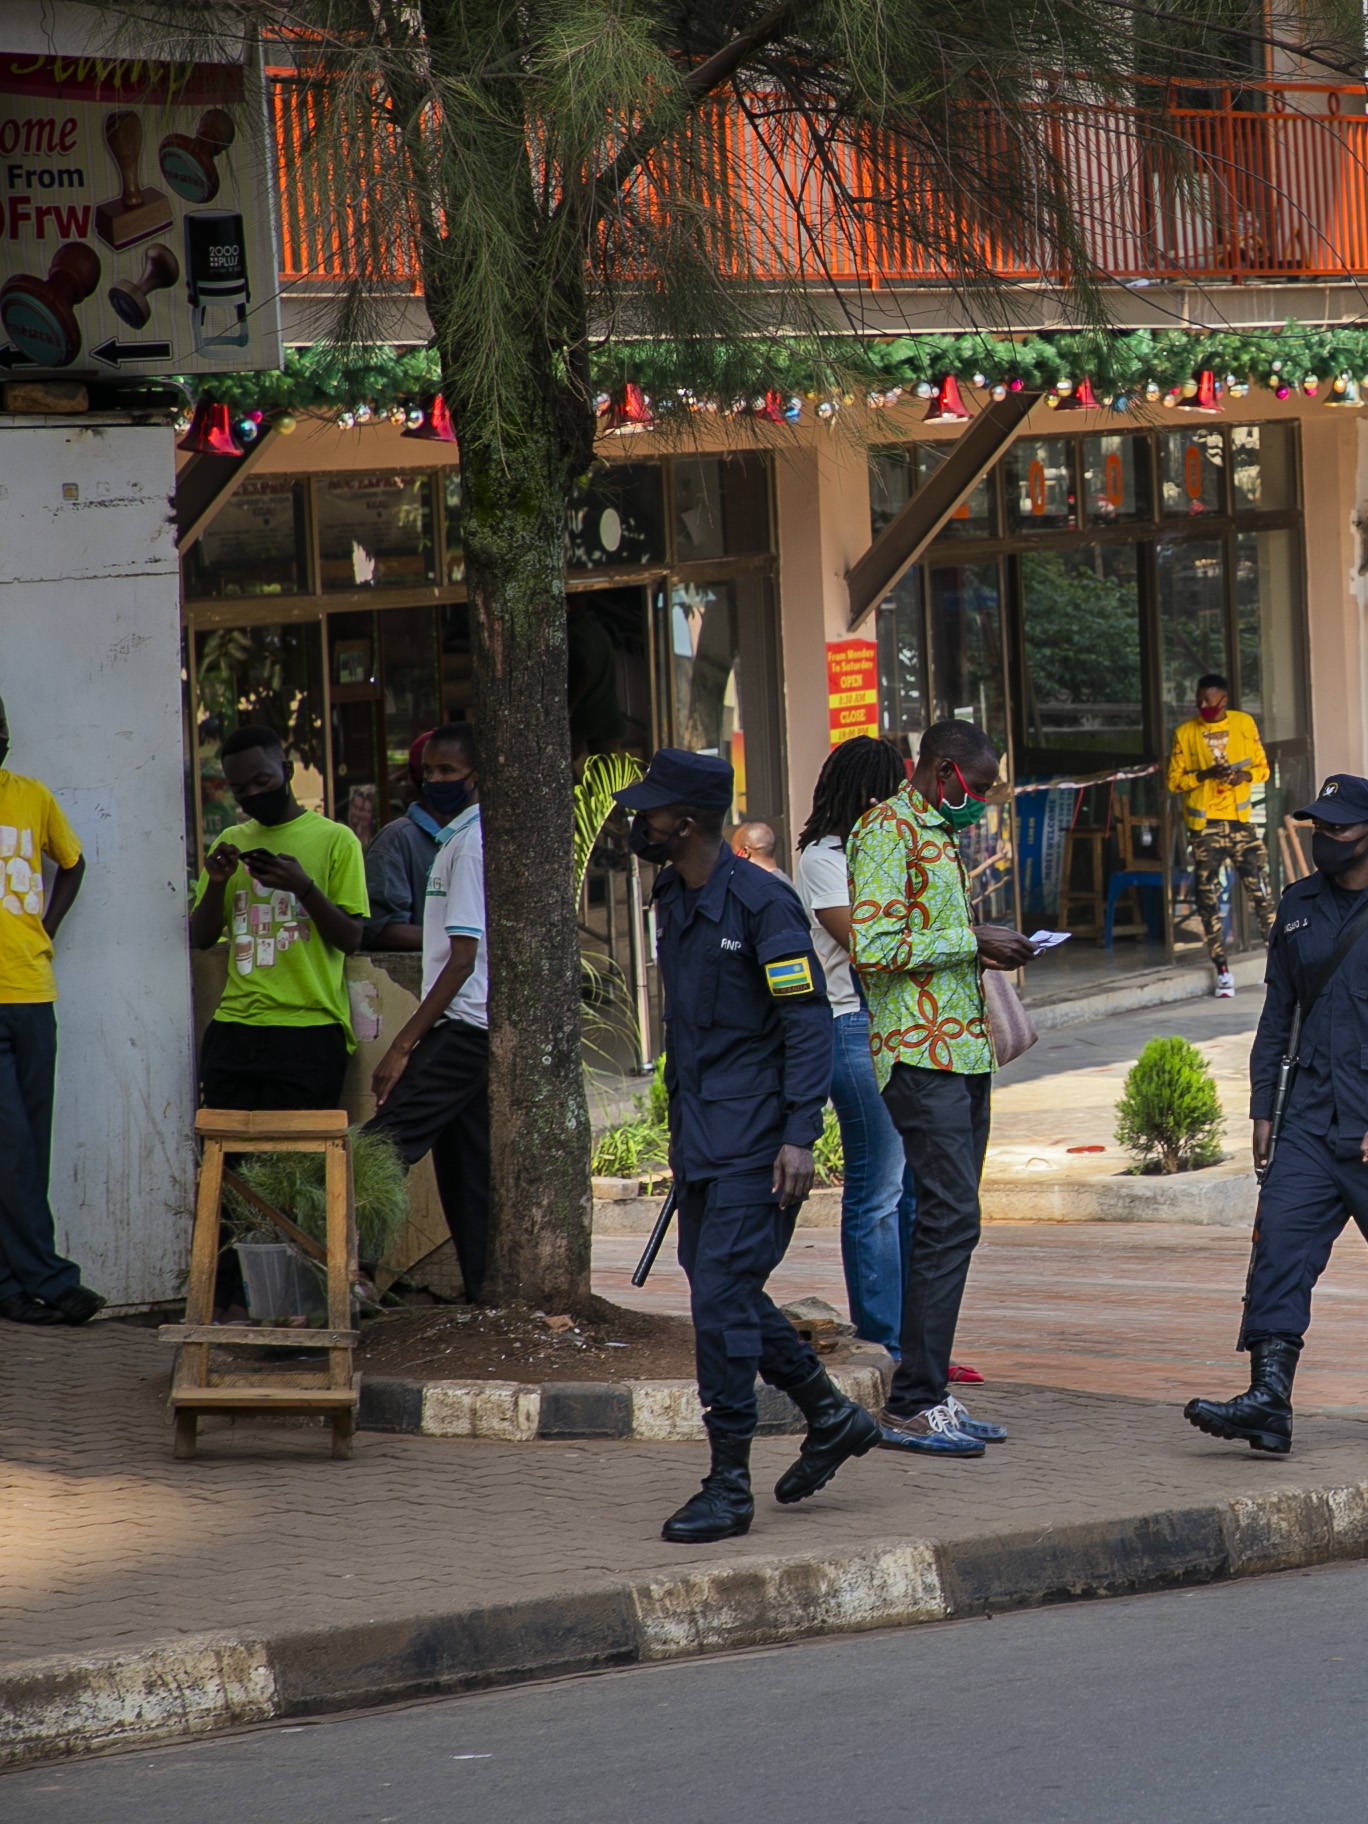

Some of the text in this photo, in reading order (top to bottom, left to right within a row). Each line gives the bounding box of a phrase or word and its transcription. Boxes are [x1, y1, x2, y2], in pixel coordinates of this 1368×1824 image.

[7, 165, 85, 189] From
[0, 196, 91, 242] Frw
[209, 245, 240, 257] 2000
[827, 648, 875, 662] From Monday
[831, 659, 873, 673] To Saturday
[840, 674, 863, 689] OPEN
[840, 708, 866, 724] CLOSE
[1046, 799, 1056, 850] WELCOME
[720, 937, 742, 951] RNP
